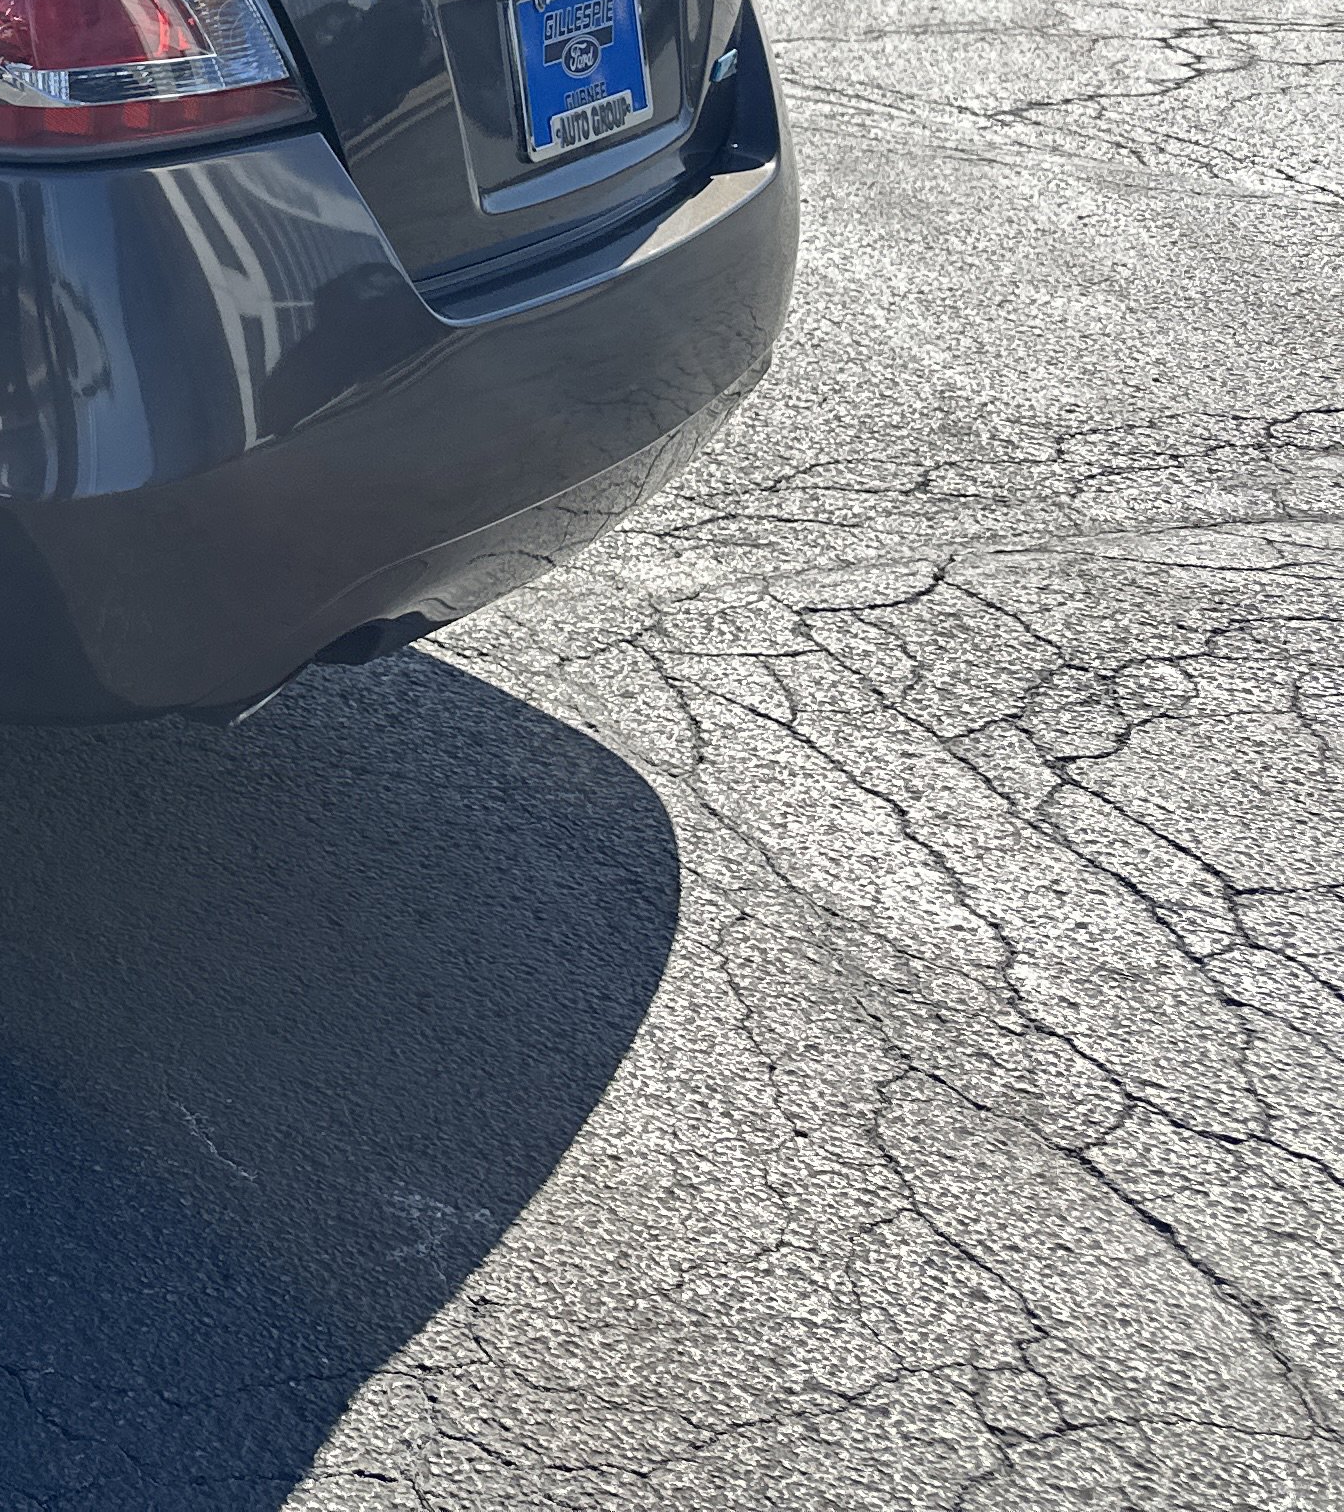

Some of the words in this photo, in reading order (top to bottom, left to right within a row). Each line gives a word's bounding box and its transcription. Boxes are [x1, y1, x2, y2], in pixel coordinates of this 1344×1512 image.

[569, 42, 595, 71] Ford
[560, 111, 590, 148] AUTO
[590, 96, 627, 137] GROUP
